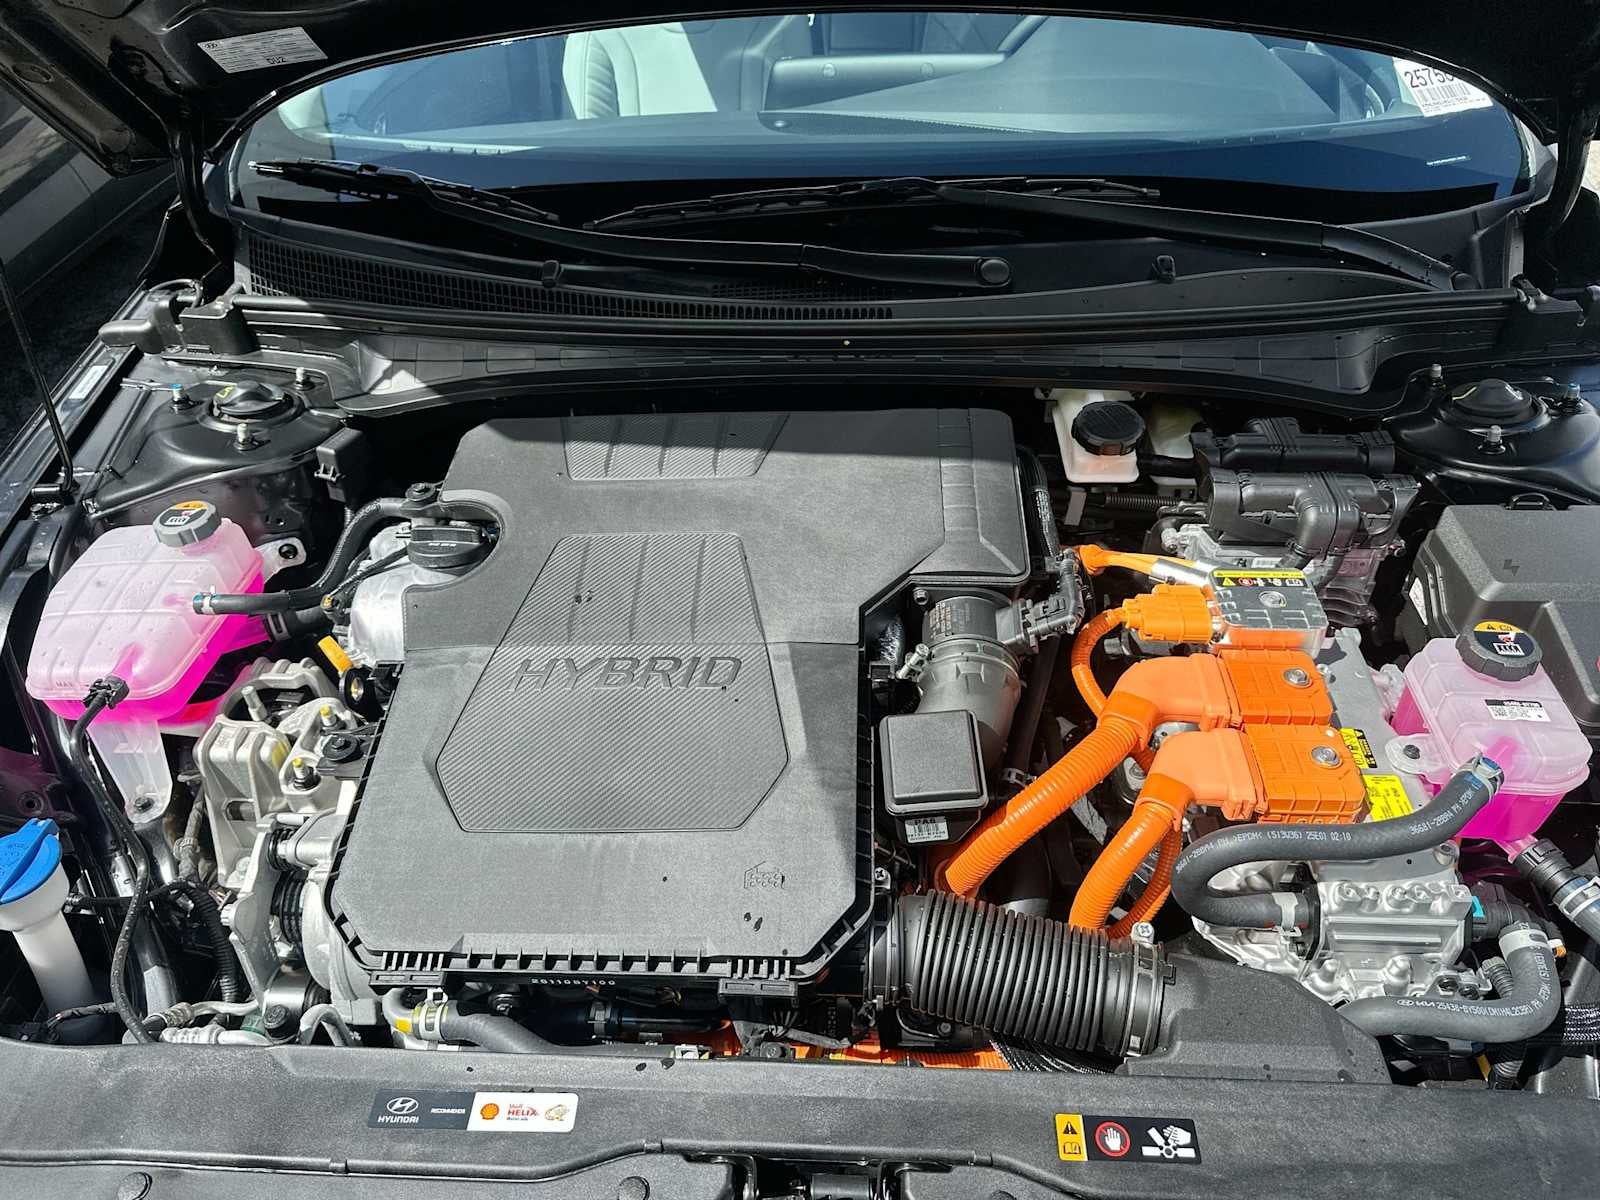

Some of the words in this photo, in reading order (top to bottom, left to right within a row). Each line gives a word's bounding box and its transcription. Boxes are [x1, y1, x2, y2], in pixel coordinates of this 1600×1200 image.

[508, 656, 742, 691] HYBRID
[507, 1108, 538, 1116] HELIX
[377, 1115, 419, 1123] HYUNDAI
